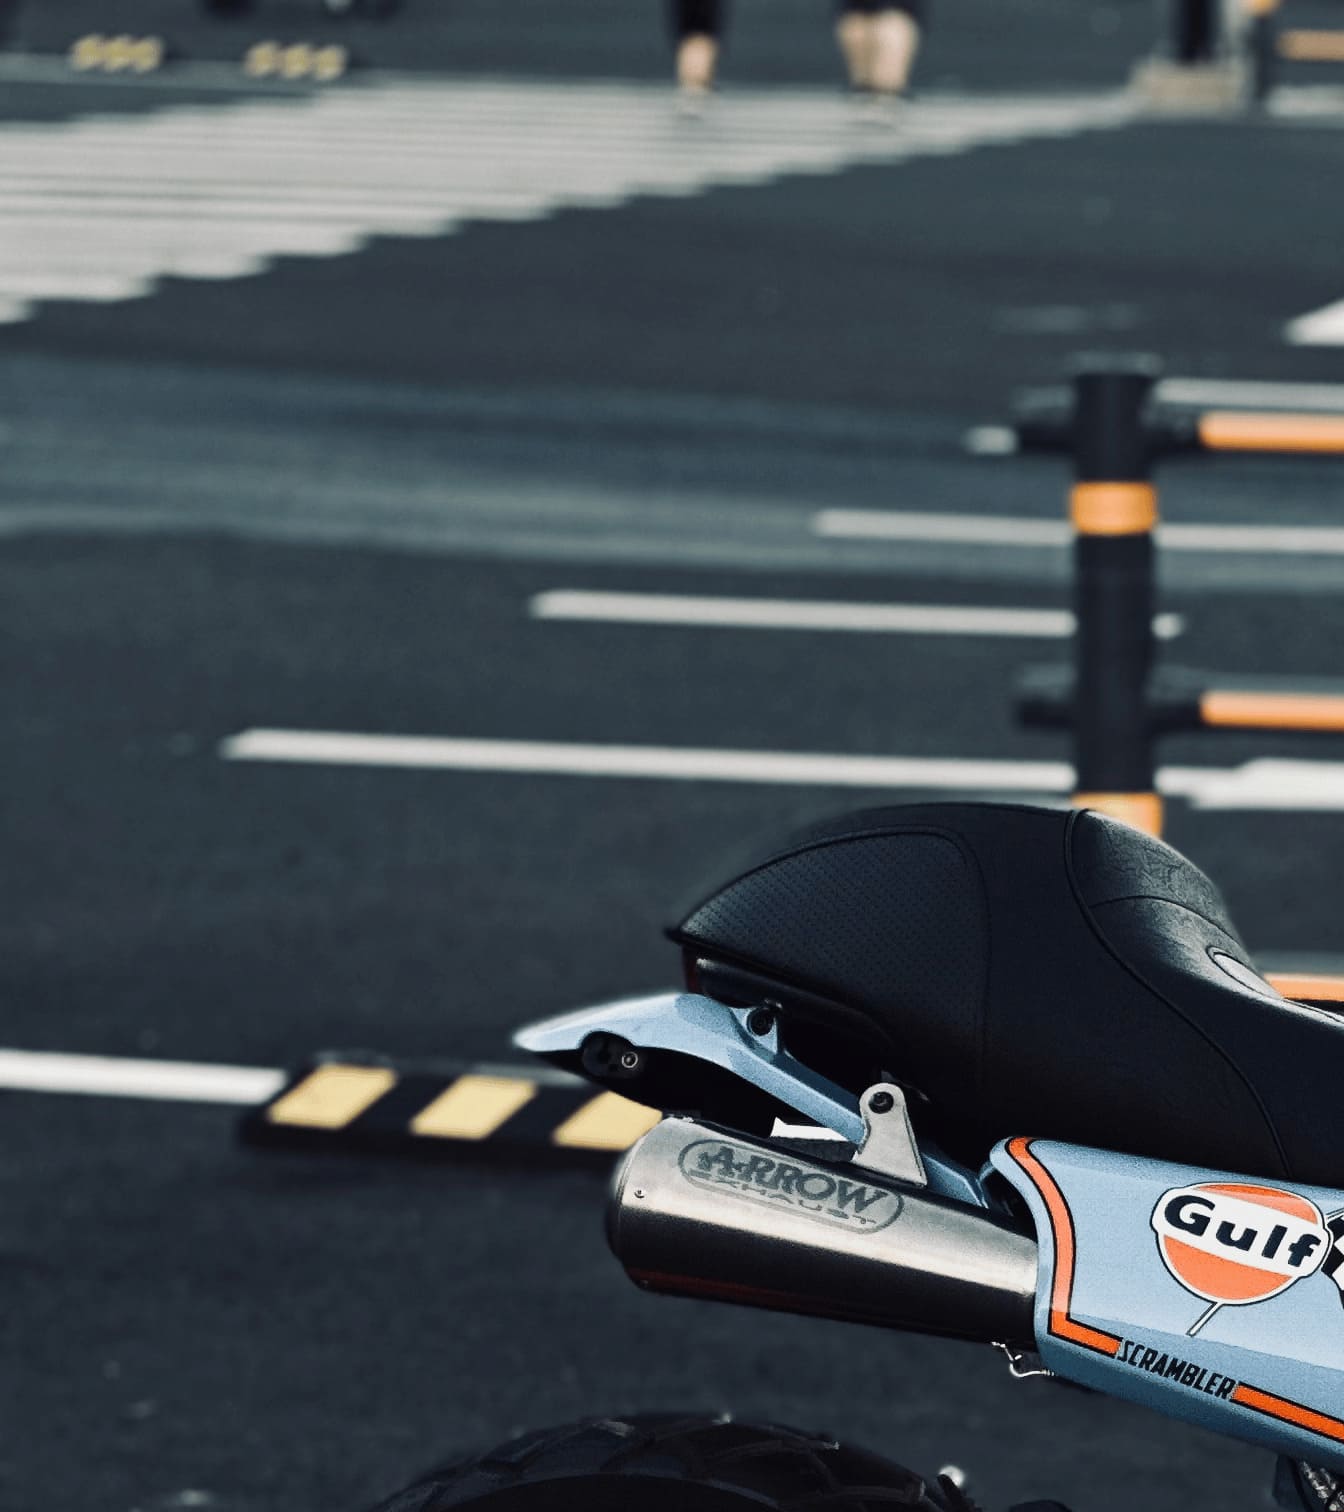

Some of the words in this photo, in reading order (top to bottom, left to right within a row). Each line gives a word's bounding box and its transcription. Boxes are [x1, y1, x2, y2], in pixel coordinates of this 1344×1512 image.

[697, 1145, 888, 1213] ARROW
[1164, 1194, 1321, 1267] Gulf
[1119, 1340, 1235, 1401] SCRAMBLER
